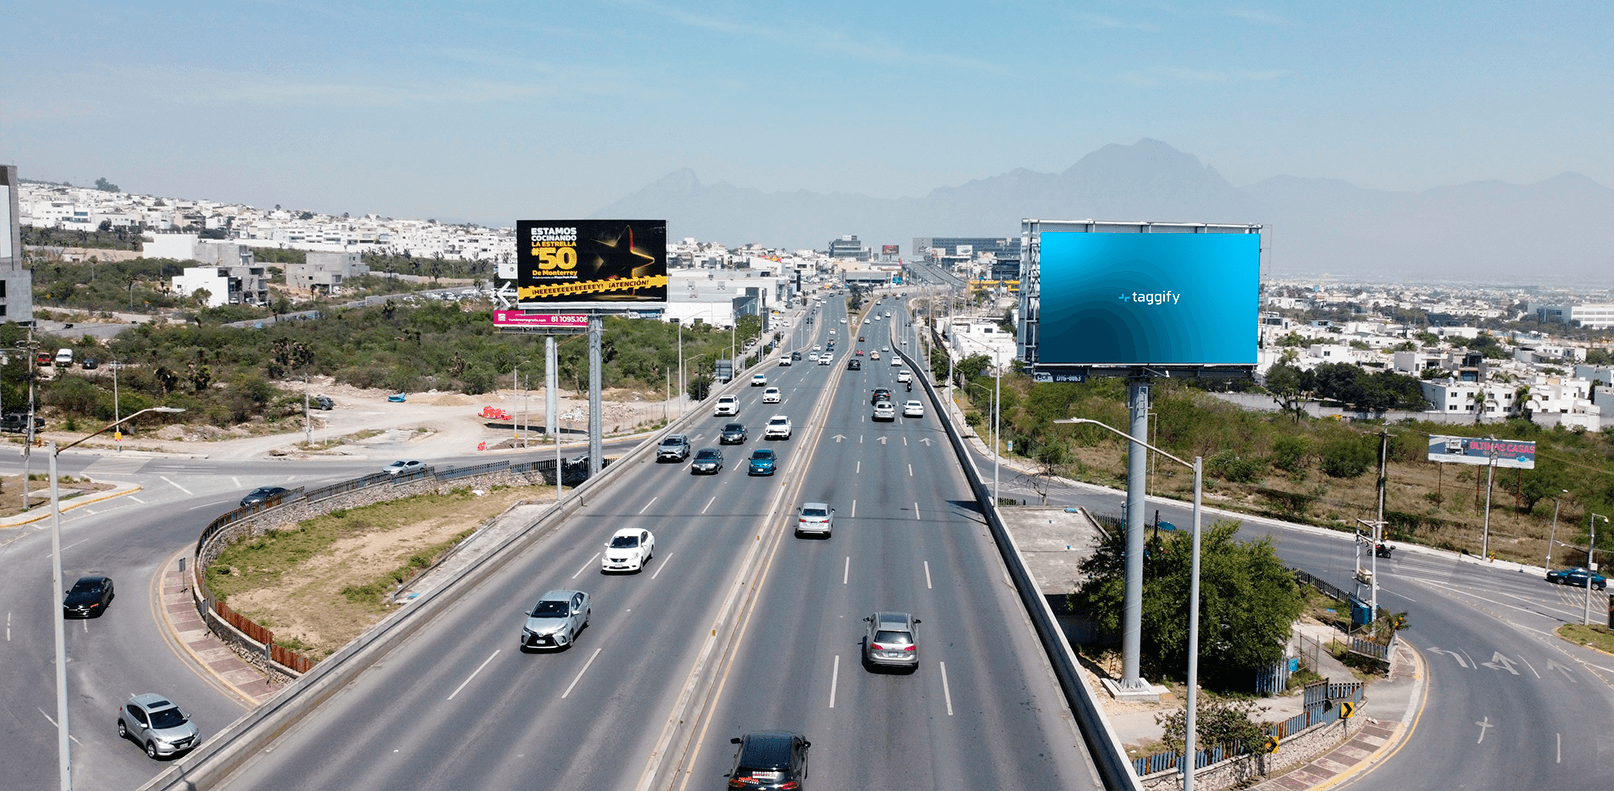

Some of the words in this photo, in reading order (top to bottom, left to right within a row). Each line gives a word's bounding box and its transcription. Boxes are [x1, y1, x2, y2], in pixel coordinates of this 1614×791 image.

[531, 227, 577, 235] ESTAMOS
[1132, 290, 1180, 305] taggify
[1506, 444, 1536, 454] CASAS
